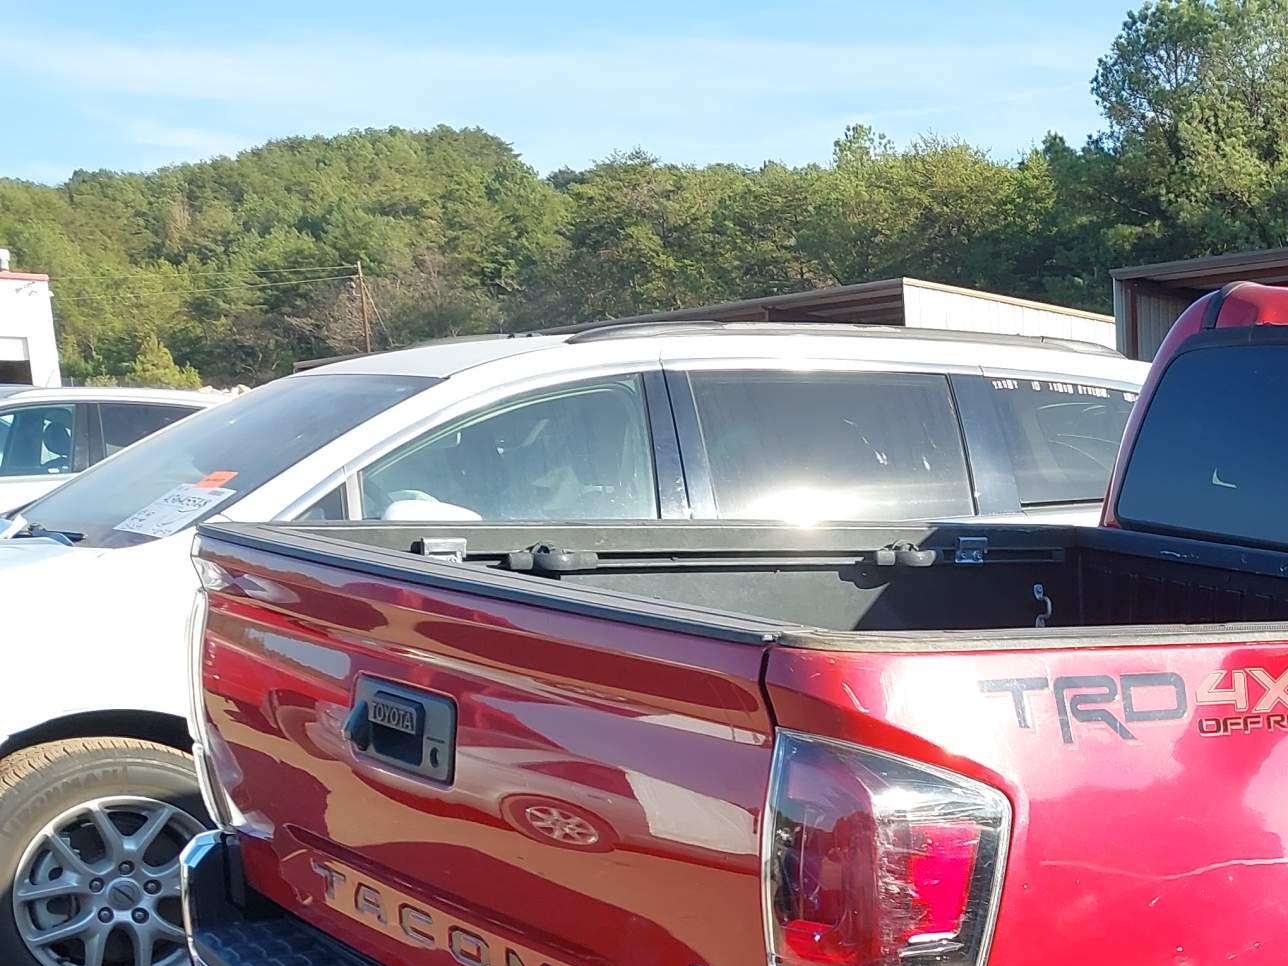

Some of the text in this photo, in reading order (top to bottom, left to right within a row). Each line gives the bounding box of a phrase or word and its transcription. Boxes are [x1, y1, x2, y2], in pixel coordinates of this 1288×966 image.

[370, 701, 414, 732] TOYOTA
[978, 671, 1188, 745] TRD
[1199, 716, 1262, 737] OFF
